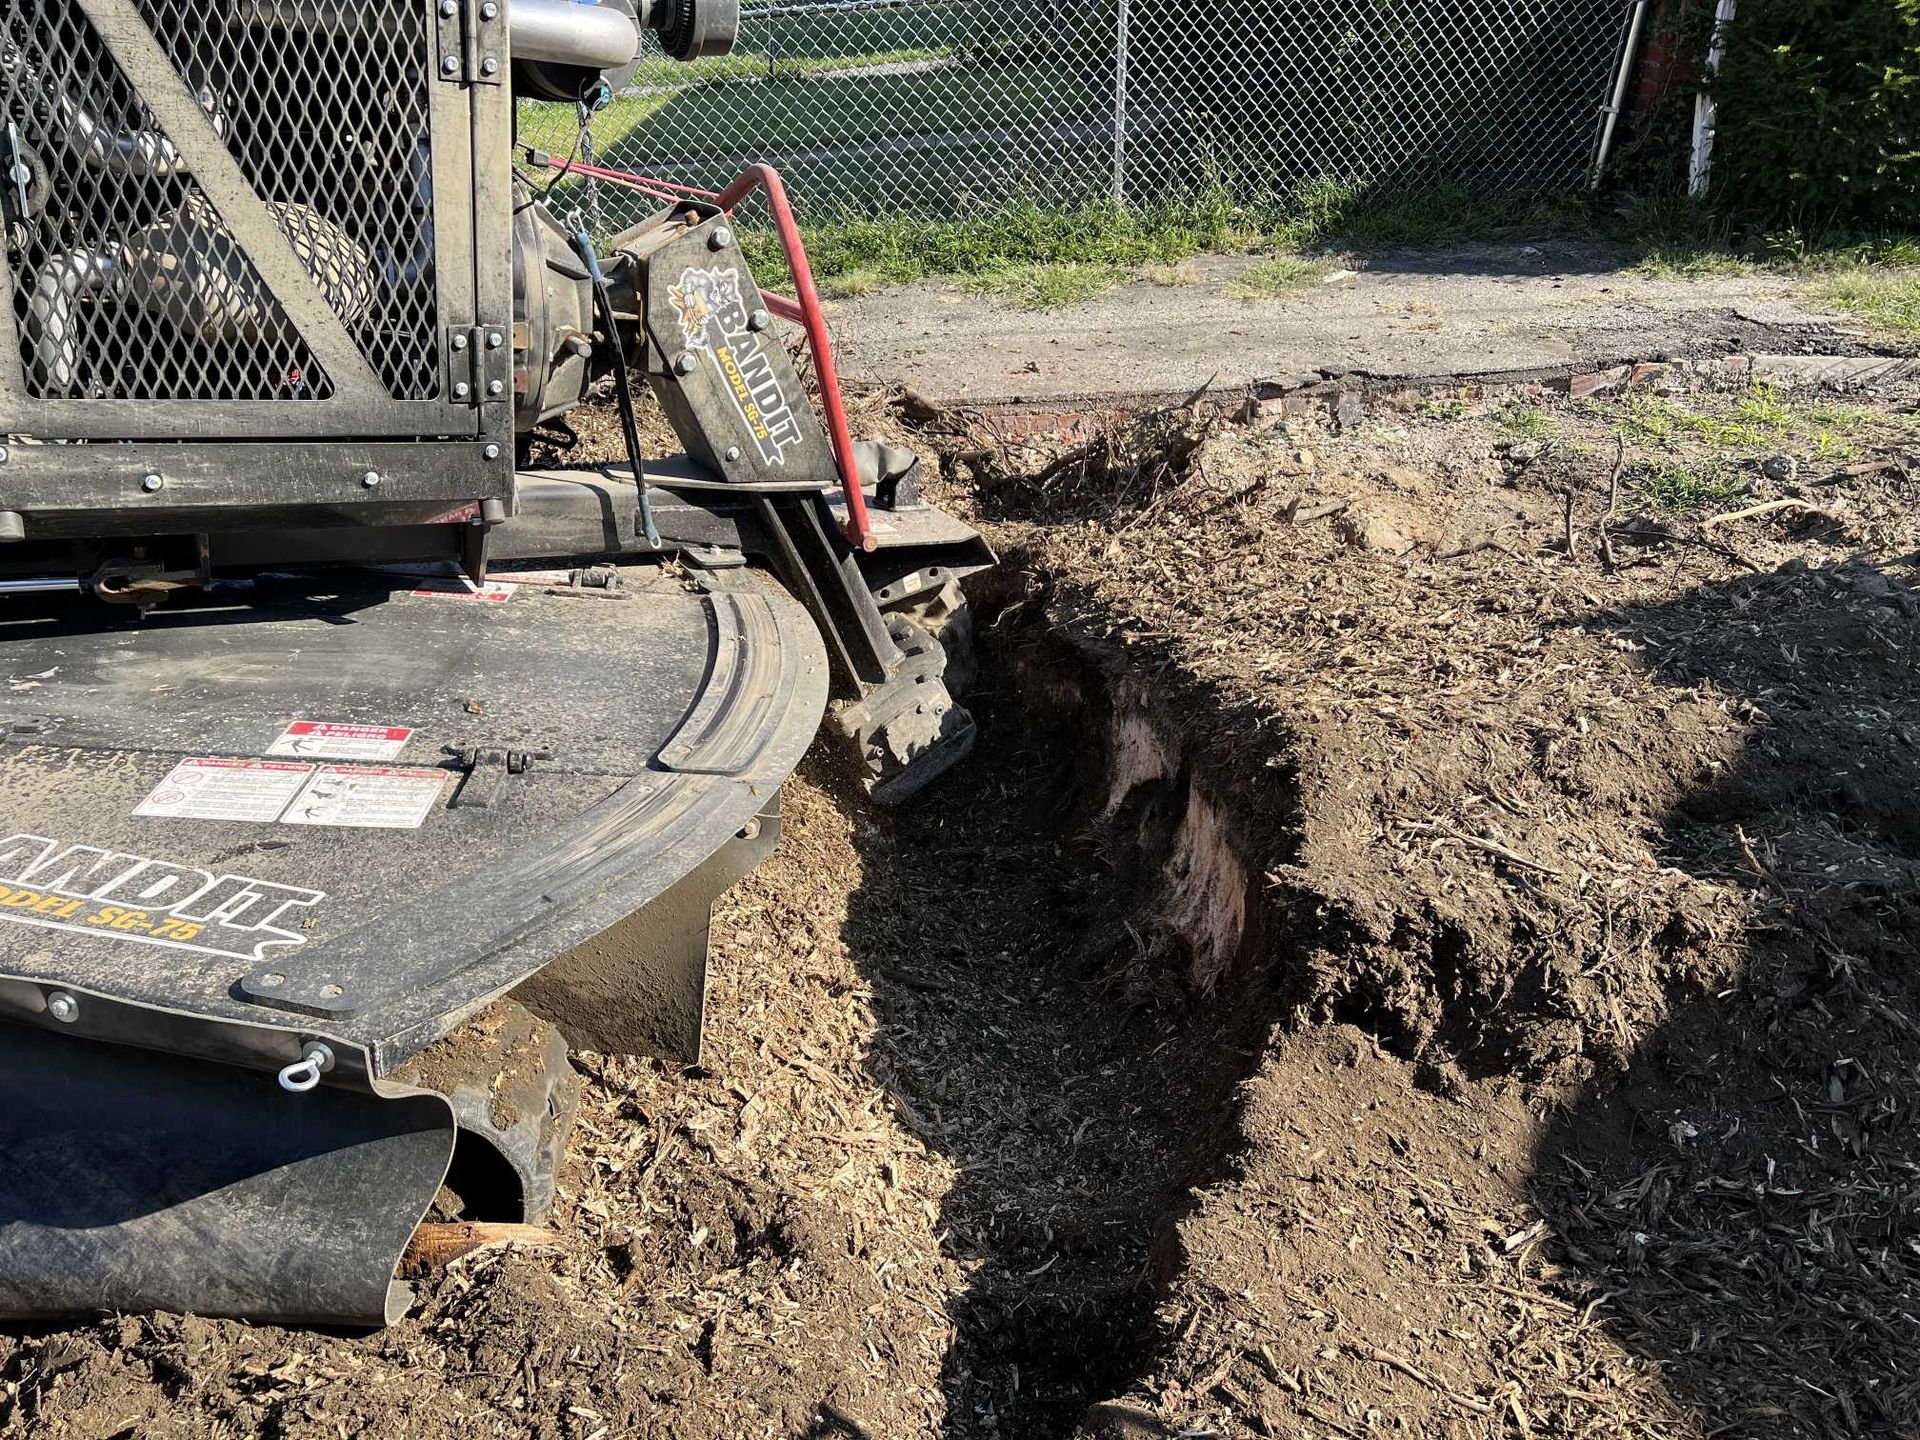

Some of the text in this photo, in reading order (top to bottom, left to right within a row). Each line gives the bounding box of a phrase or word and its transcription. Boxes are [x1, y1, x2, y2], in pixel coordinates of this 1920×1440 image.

[715, 301, 802, 448] BANDIT
[717, 346, 768, 439] MODEL SG-75
[324, 731, 387, 740] PELIGRO
[329, 725, 388, 734] DANGER
[0, 886, 206, 941] DEL SG-75
